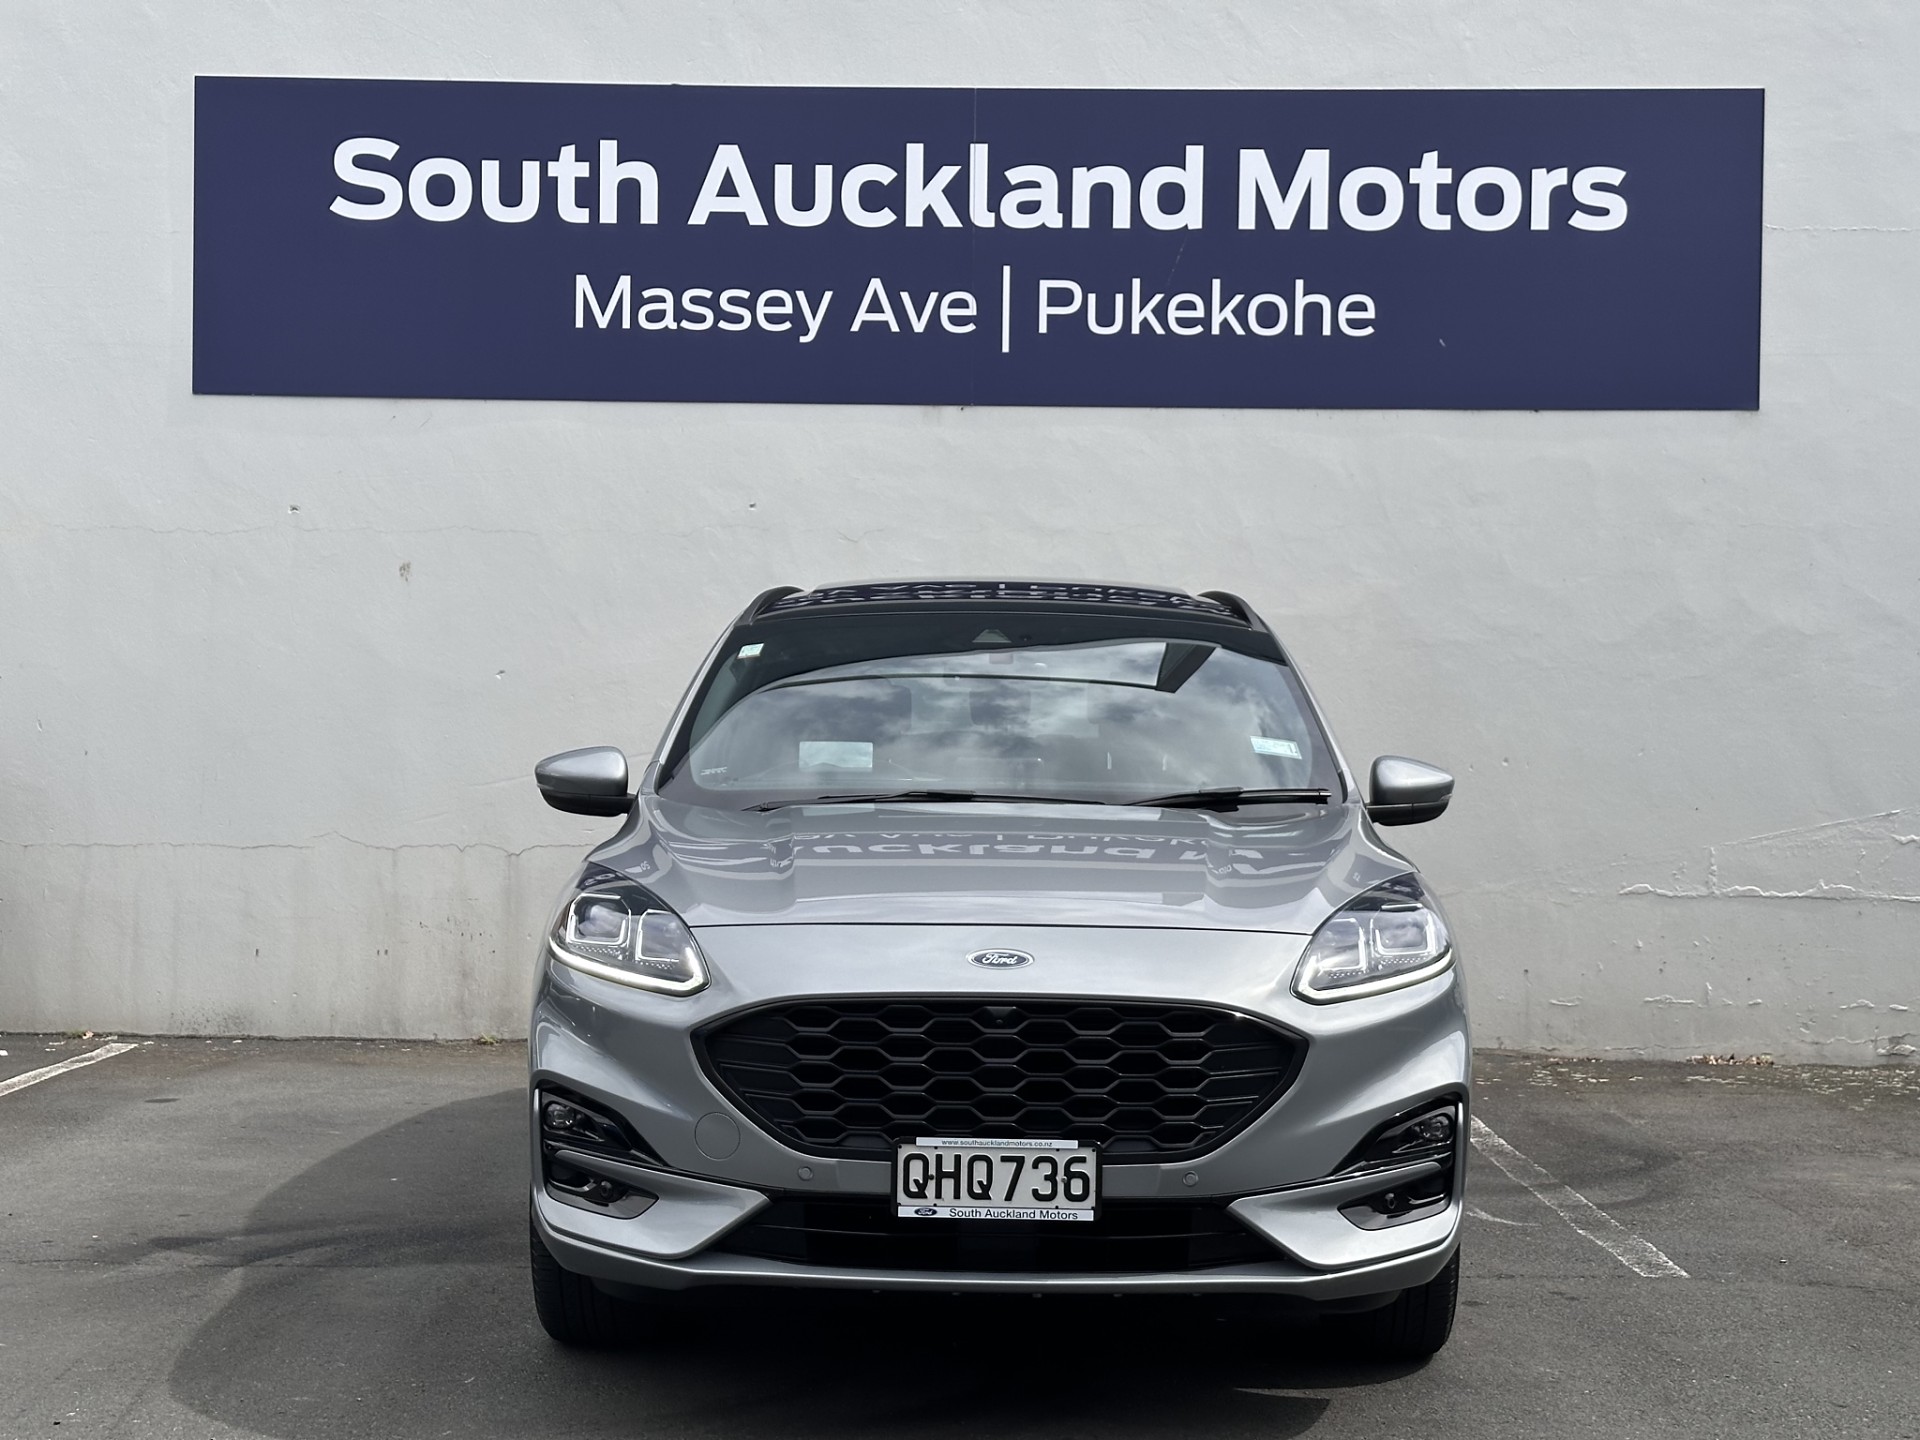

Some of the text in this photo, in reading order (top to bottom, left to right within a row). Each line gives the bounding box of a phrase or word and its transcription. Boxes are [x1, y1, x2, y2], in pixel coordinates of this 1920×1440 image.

[330, 138, 1628, 232] South Auckland Motors
[575, 274, 833, 343] Massey
[850, 277, 977, 334] Ave
[1038, 277, 1376, 337] Pukekohe
[982, 953, 1018, 964] Ford
[941, 1139, 1053, 1148] www.southaucklandmotors.co.nz
[903, 1153, 1090, 1202] QHQ736
[949, 1208, 1078, 1220] South Auckland Motors
